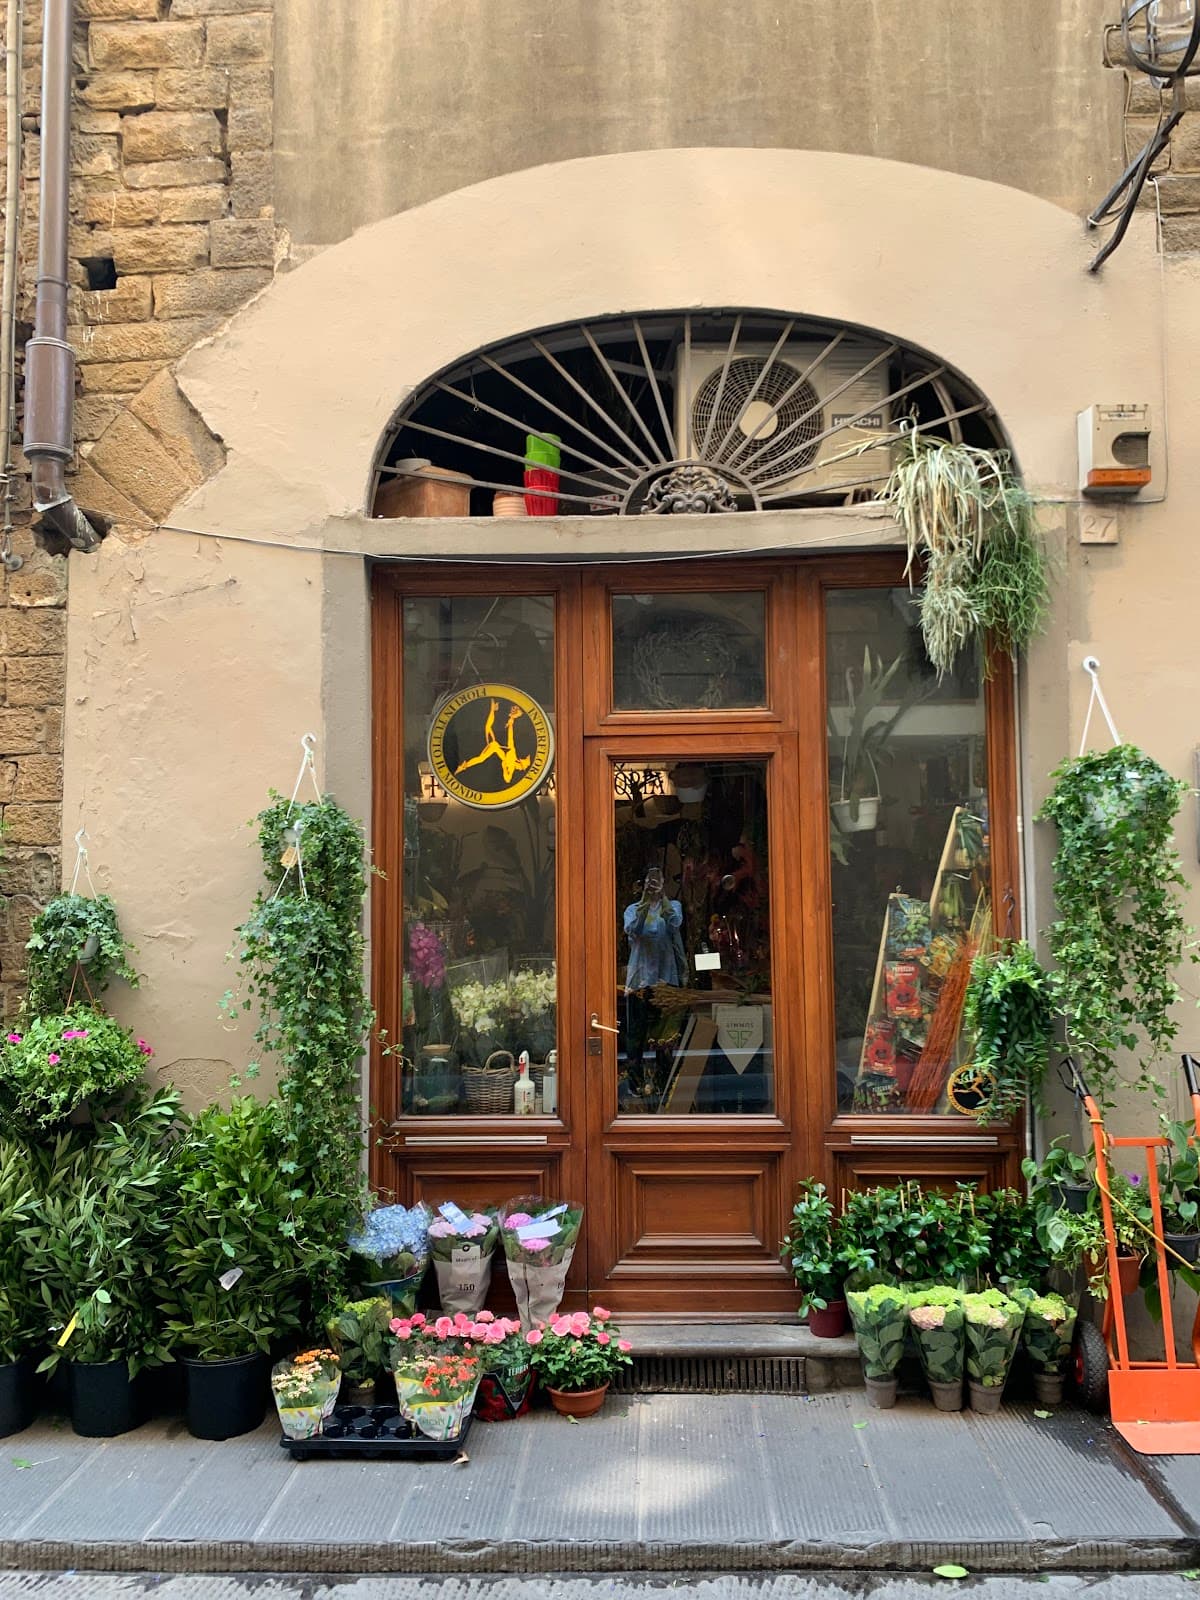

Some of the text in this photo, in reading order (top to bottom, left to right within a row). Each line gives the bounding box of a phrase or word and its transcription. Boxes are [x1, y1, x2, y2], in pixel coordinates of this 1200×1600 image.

[1083, 514, 1115, 538] 27
[456, 687, 487, 706] FIORI
[525, 707, 546, 781] INTERFLORA
[443, 772, 483, 802] MONDO
